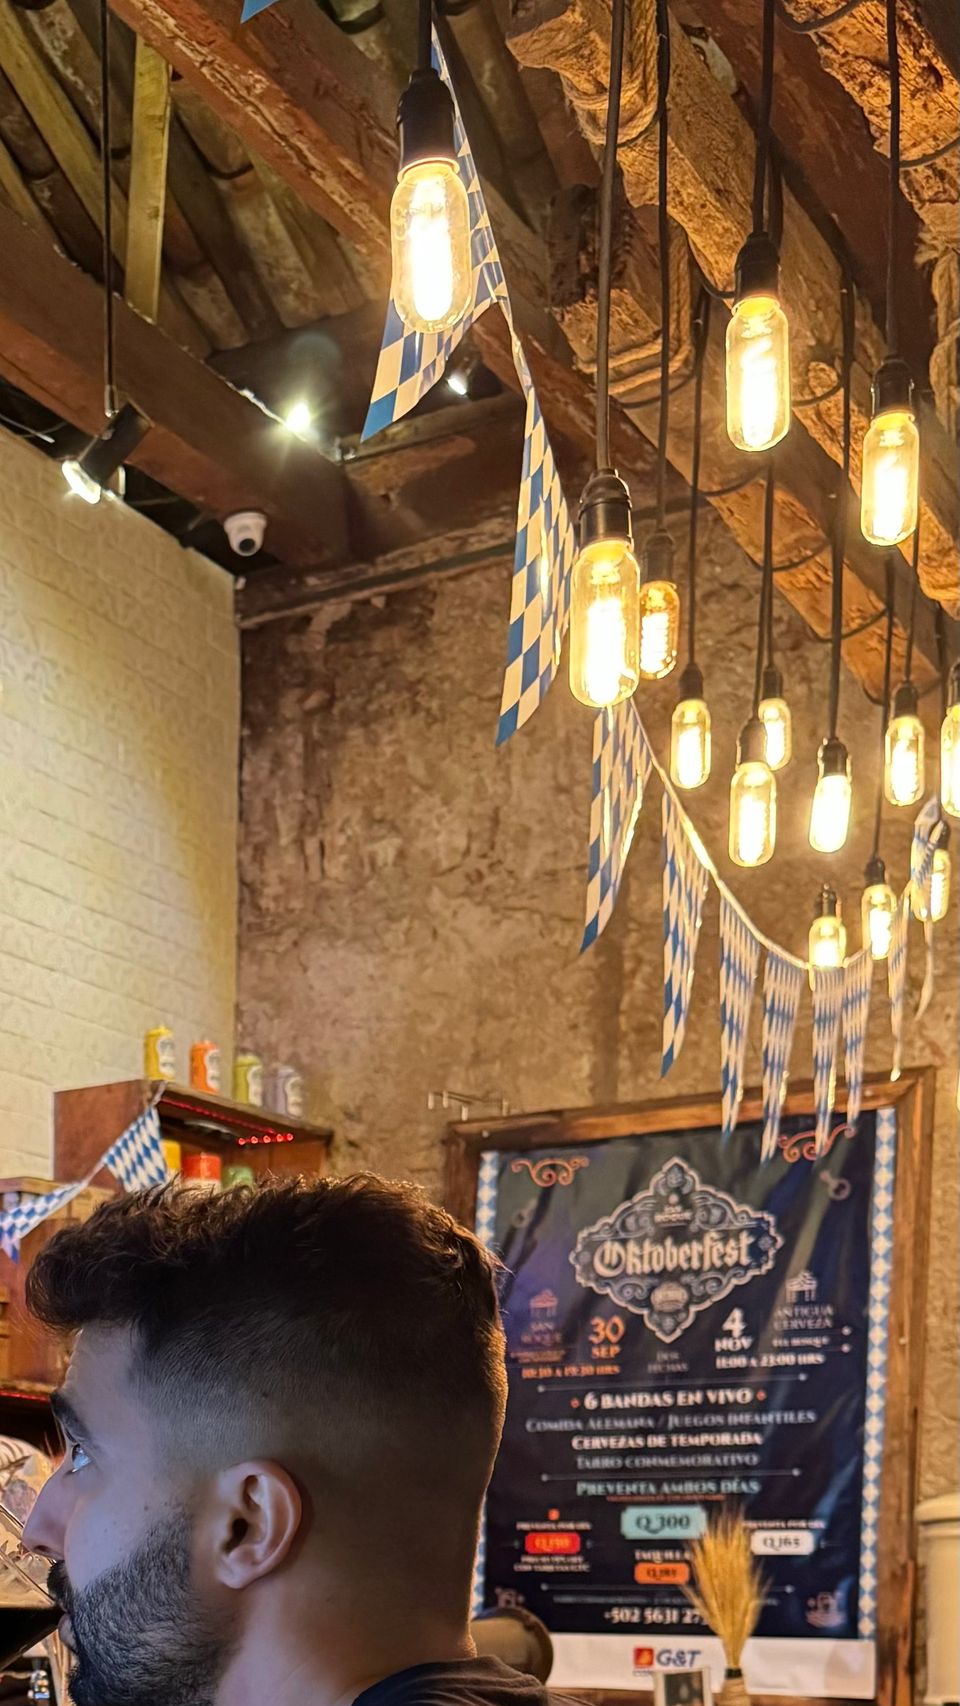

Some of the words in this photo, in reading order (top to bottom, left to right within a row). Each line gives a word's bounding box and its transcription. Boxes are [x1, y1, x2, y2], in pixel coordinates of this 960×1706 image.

[593, 1229, 754, 1278] Oktoberfest
[589, 1315, 626, 1344] 30
[722, 1308, 747, 1337] 4
[774, 1317, 832, 1330] CERVEZA
[591, 1345, 621, 1359] SEP
[714, 1336, 753, 1351] NOV
[583, 1391, 599, 1410] 6
[600, 1391, 674, 1409] BANDAS
[677, 1390, 703, 1406] EN
[706, 1388, 754, 1405] VIVO
[571, 1434, 645, 1450] CERVEZAS
[647, 1434, 667, 1448] DE
[670, 1431, 764, 1448] TEMPORADA
[576, 1480, 657, 1496] PREVENTA
[660, 1480, 717, 1495] AMBOS
[656, 1649, 701, 1667] G&T
